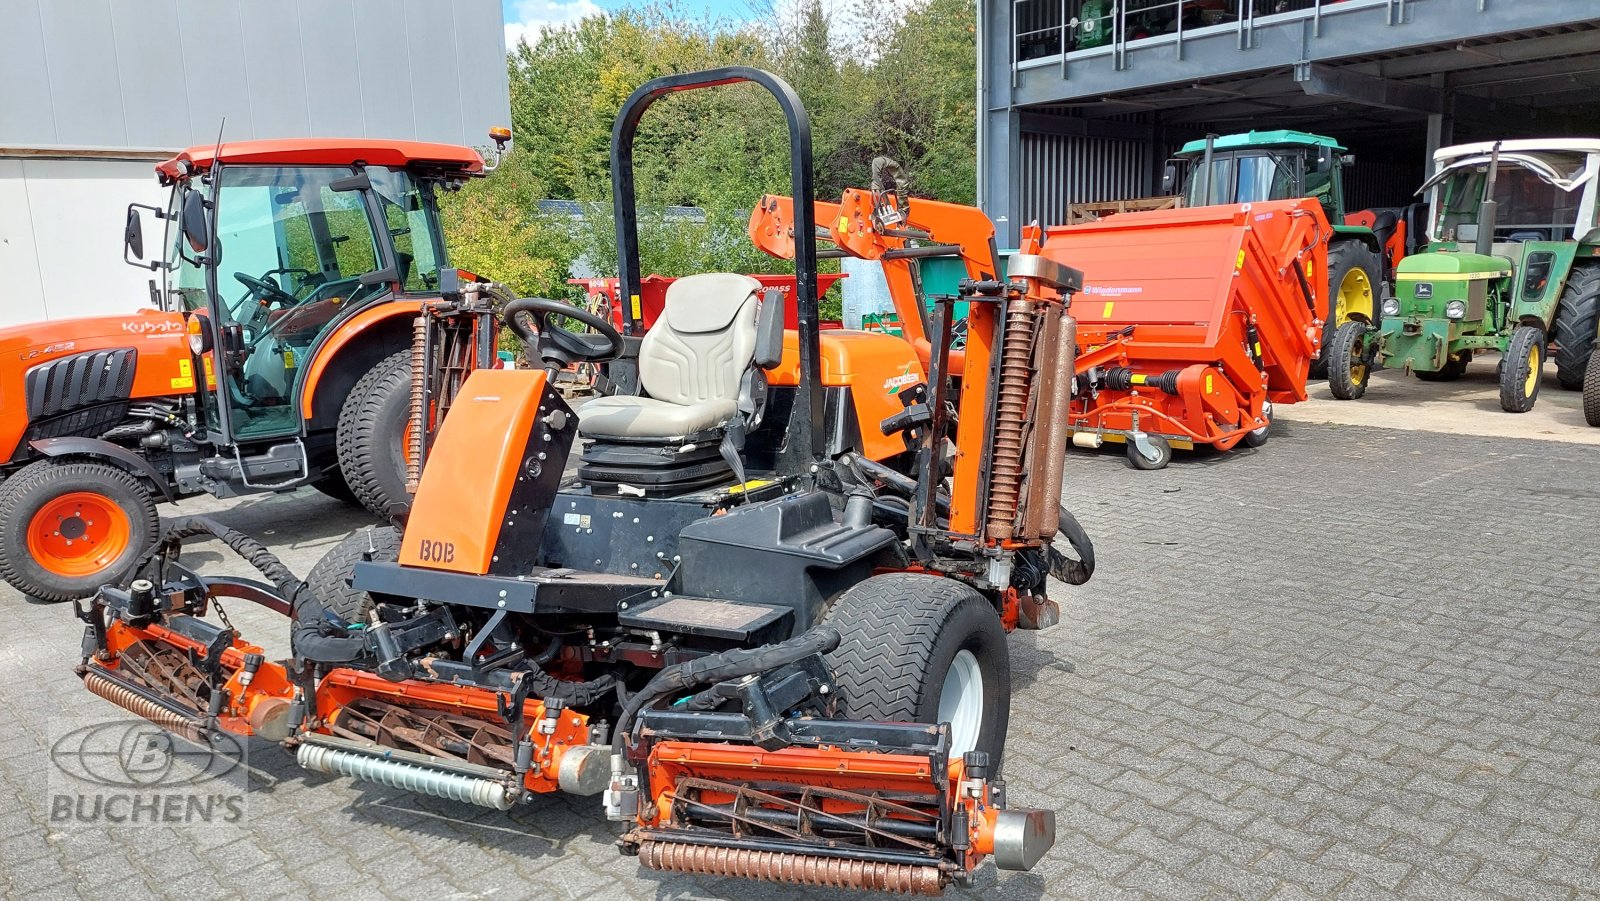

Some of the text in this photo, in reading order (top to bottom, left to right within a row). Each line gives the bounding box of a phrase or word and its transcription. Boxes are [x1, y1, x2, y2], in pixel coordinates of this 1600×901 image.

[758, 285, 791, 293] OPASS
[1092, 286, 1143, 294] Wiedenmann
[122, 320, 183, 333] Kubota
[883, 372, 920, 389] JACOBSEN
[419, 539, 455, 564] BOB
